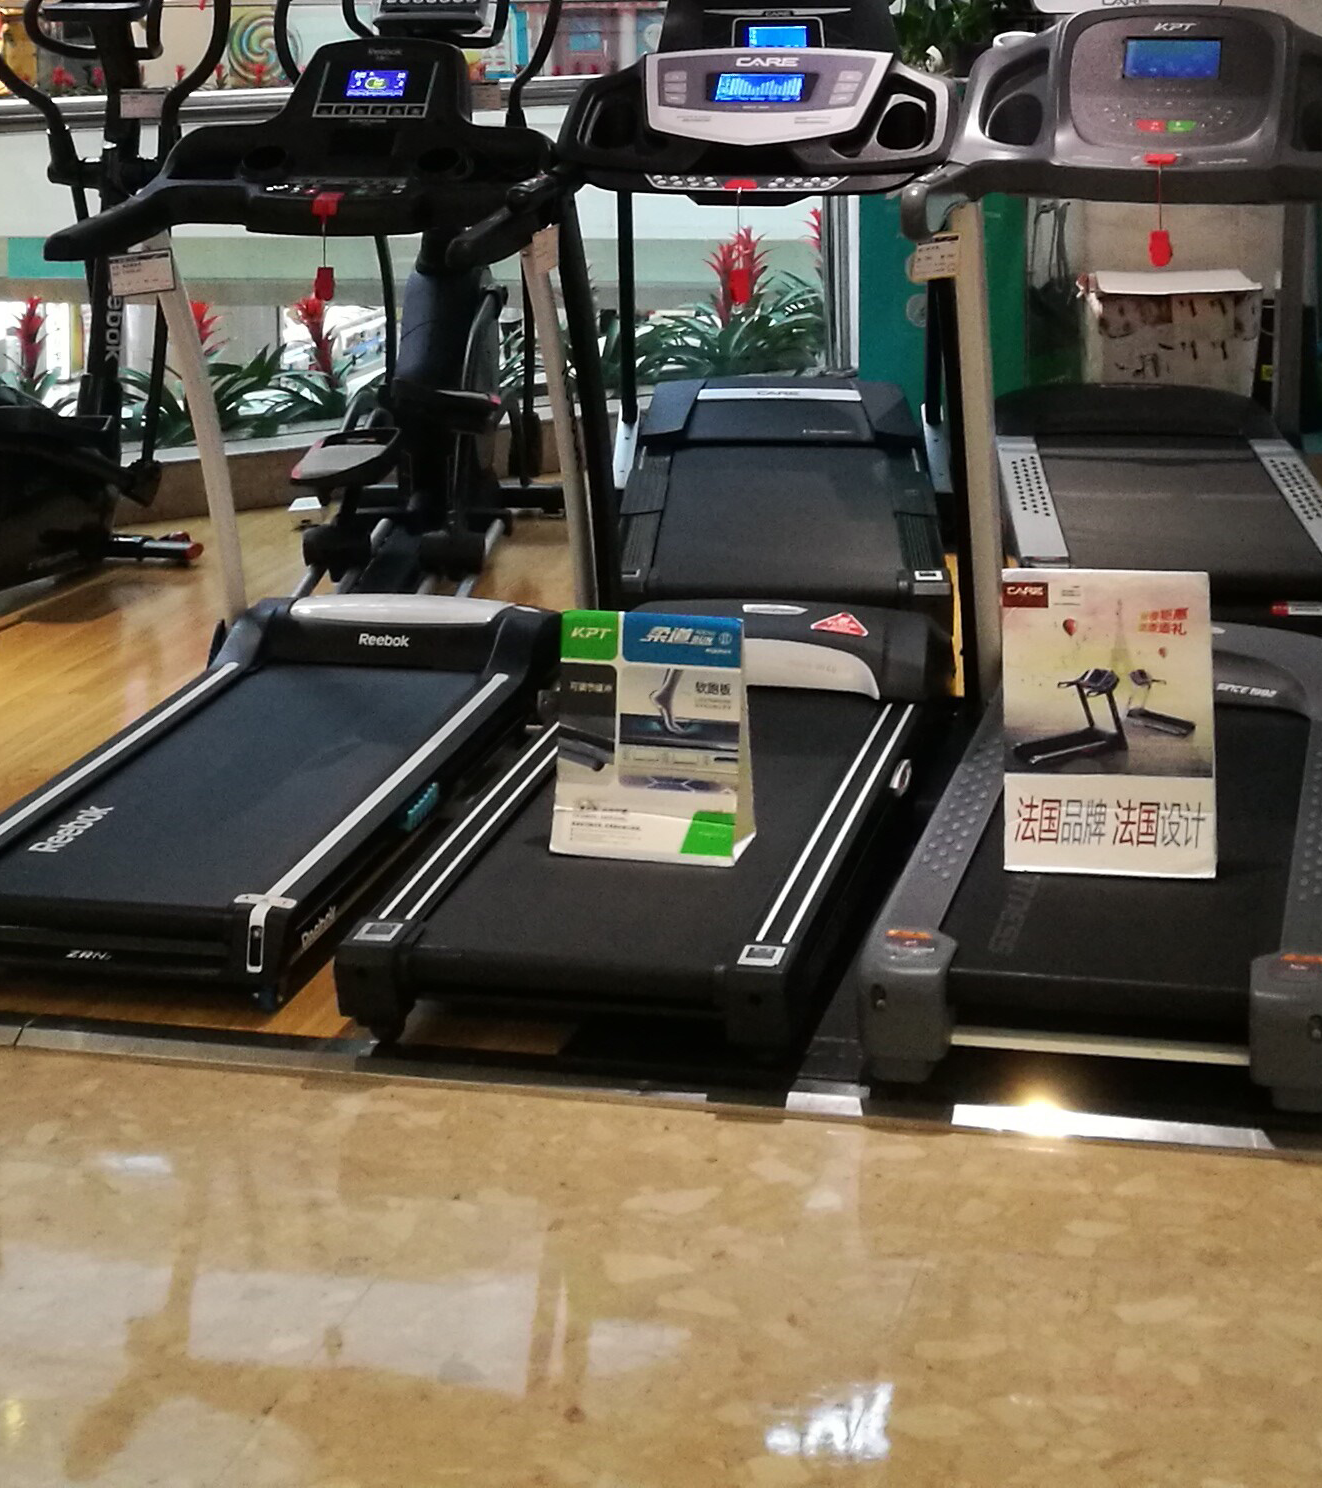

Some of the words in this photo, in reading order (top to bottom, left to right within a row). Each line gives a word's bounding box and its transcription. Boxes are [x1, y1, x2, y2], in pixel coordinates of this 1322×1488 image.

[1154, 22, 1197, 32] KPT
[735, 57, 799, 67] CARE
[104, 295, 123, 362] ebok
[358, 631, 410, 648] Reebok
[570, 626, 613, 640] KPT
[27, 805, 115, 853] Reebok
[1014, 795, 1107, 846] 法国品牌
[1111, 798, 1207, 849] 法国设计
